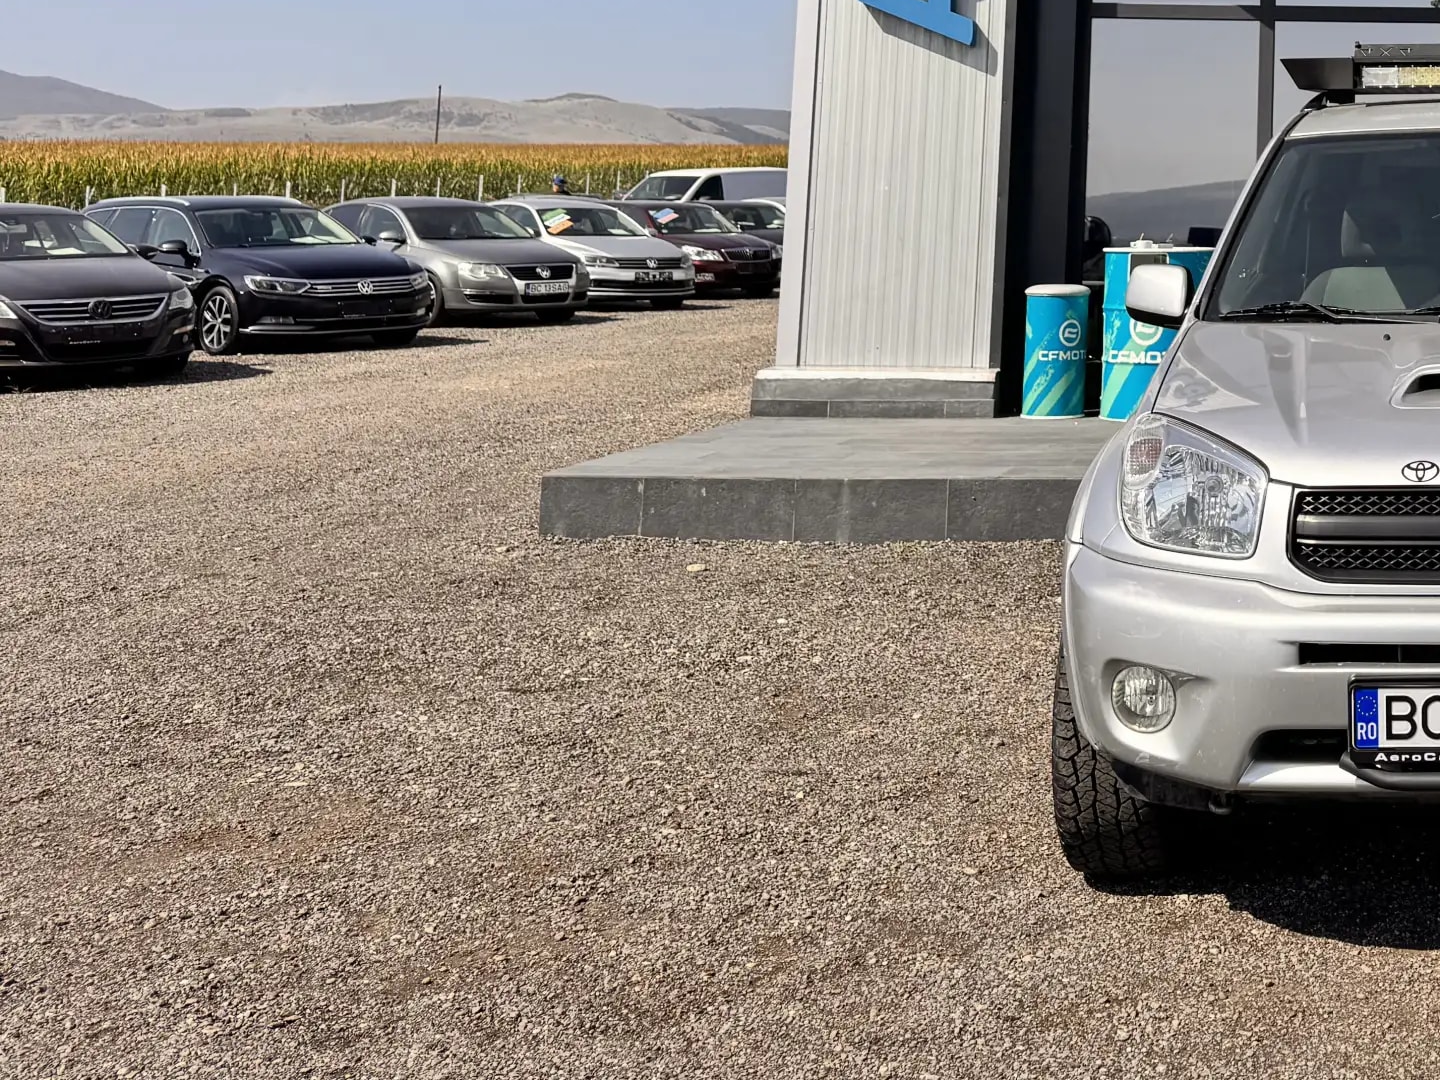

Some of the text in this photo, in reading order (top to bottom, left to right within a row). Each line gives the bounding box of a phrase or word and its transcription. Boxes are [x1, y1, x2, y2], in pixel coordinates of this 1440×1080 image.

[1038, 350, 1087, 361] CFMOT
[1108, 349, 1168, 363] CFMO
[1357, 722, 1377, 740] RO
